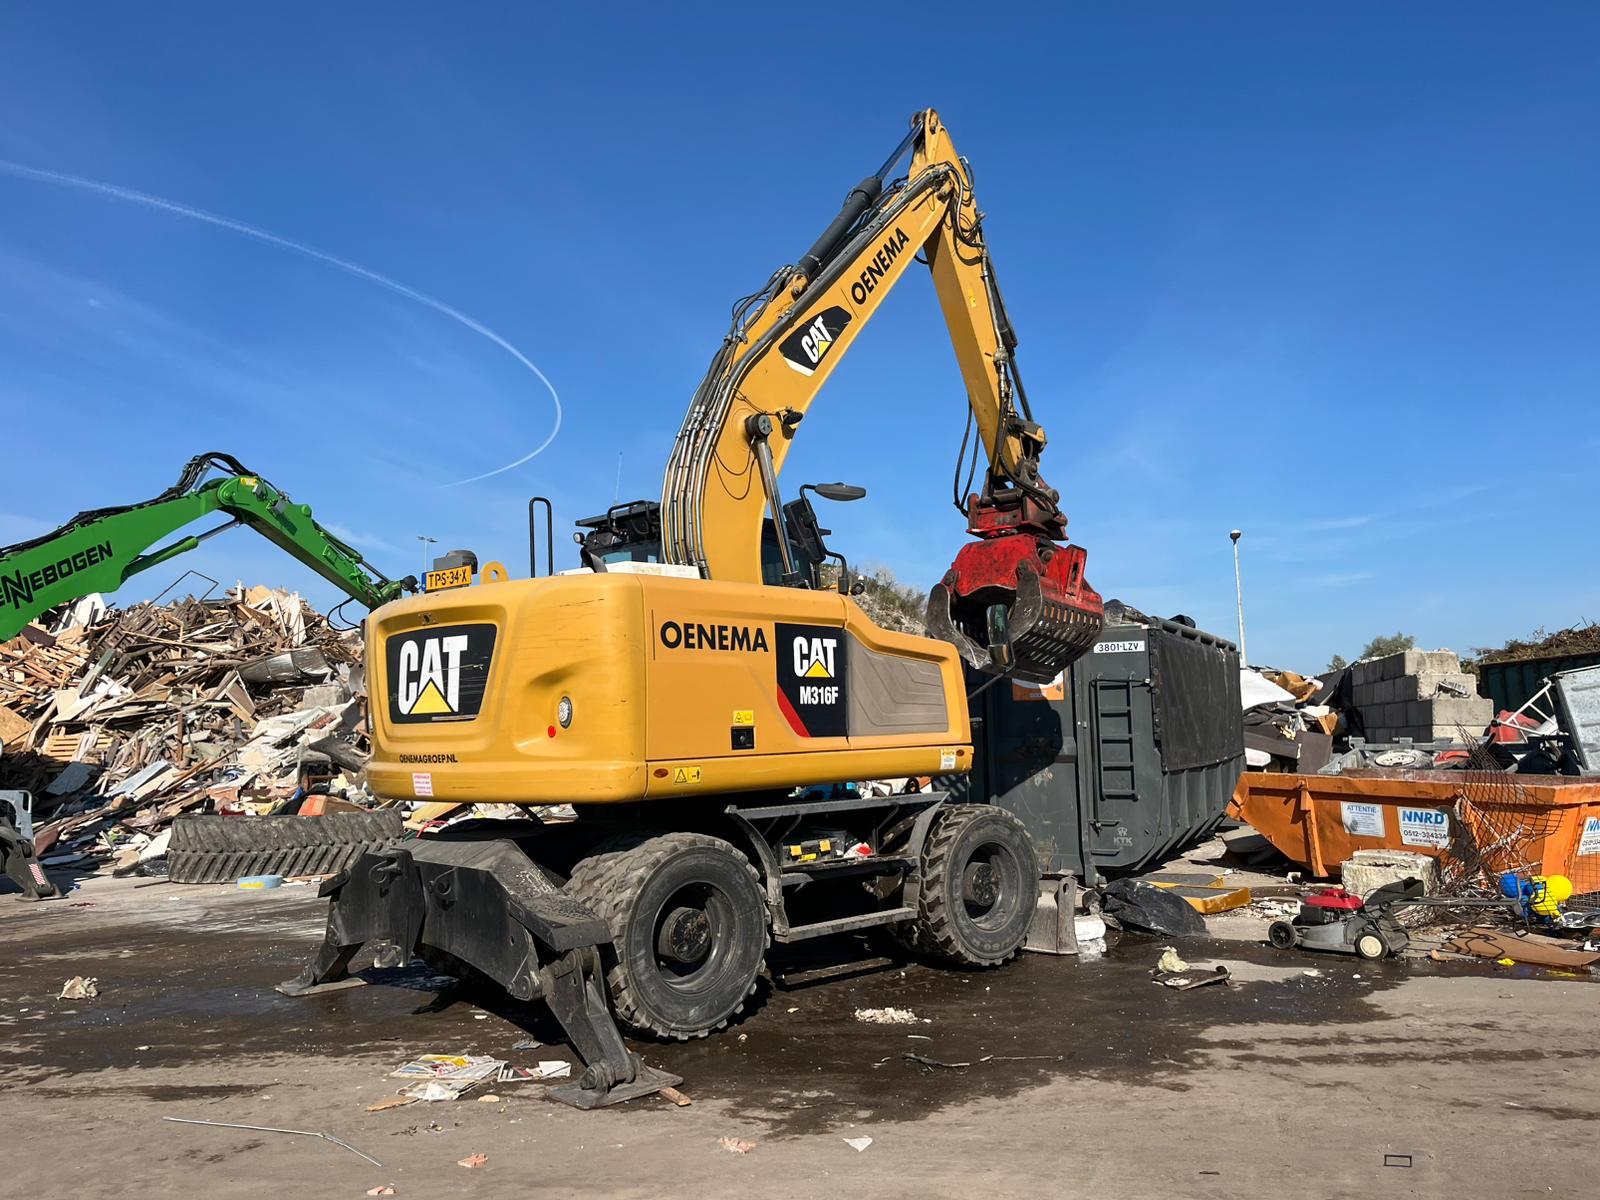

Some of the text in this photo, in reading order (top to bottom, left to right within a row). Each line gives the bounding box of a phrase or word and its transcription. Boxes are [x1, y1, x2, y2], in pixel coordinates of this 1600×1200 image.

[851, 227, 910, 305] OENEMA
[801, 315, 832, 363] CAT
[428, 568, 467, 588] TPS-34-X
[660, 620, 769, 653] OENEMA
[1098, 642, 1139, 652] 3801-LZV
[793, 636, 837, 678] CAT
[398, 634, 468, 715] CAT
[799, 685, 839, 705] M316F
[1402, 810, 1445, 825] NNRD
